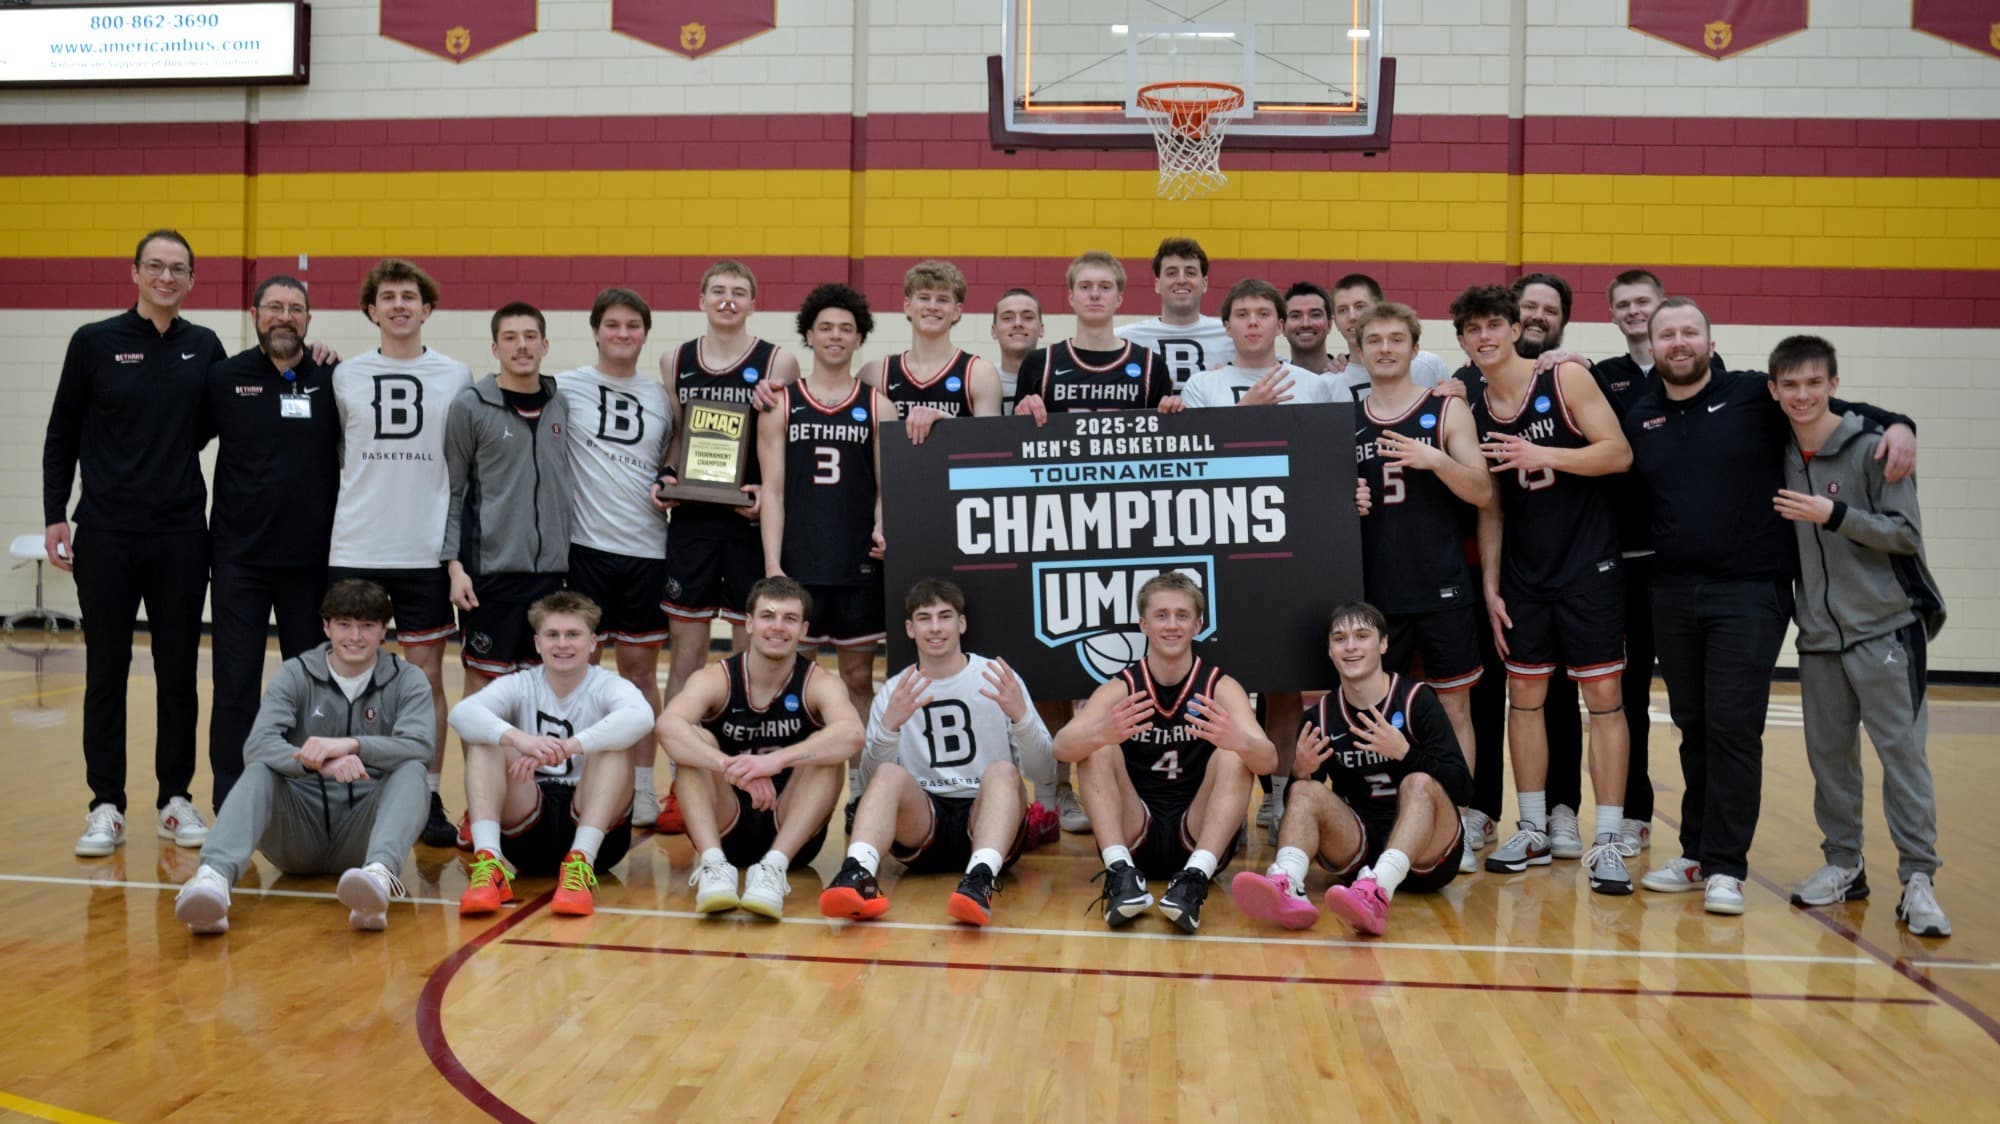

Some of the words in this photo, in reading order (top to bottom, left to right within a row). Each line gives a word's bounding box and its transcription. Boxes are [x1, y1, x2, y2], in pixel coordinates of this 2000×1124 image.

[90, 13, 218, 30] 800-862-3690
[50, 38, 260, 54] www.americanbus.com
[1054, 384, 1139, 401] BETHANY
[371, 374, 424, 440] B
[596, 384, 645, 446] B
[693, 408, 740, 436] UMAC
[790, 423, 869, 444] BETHANY
[1075, 416, 1159, 436] 2025-26
[362, 452, 433, 461] BASKETBALL
[1022, 439, 1081, 459] MEN'S
[1090, 434, 1215, 456] BASKETBALL
[813, 446, 841, 485] 3
[1030, 462, 1208, 483] TOURNAMENT
[1383, 464, 1406, 504] 5
[956, 485, 1286, 555] CHAMPIONS
[922, 699, 976, 768] B
[1151, 750, 1183, 780] 4
[920, 777, 981, 787] BASKETBA
